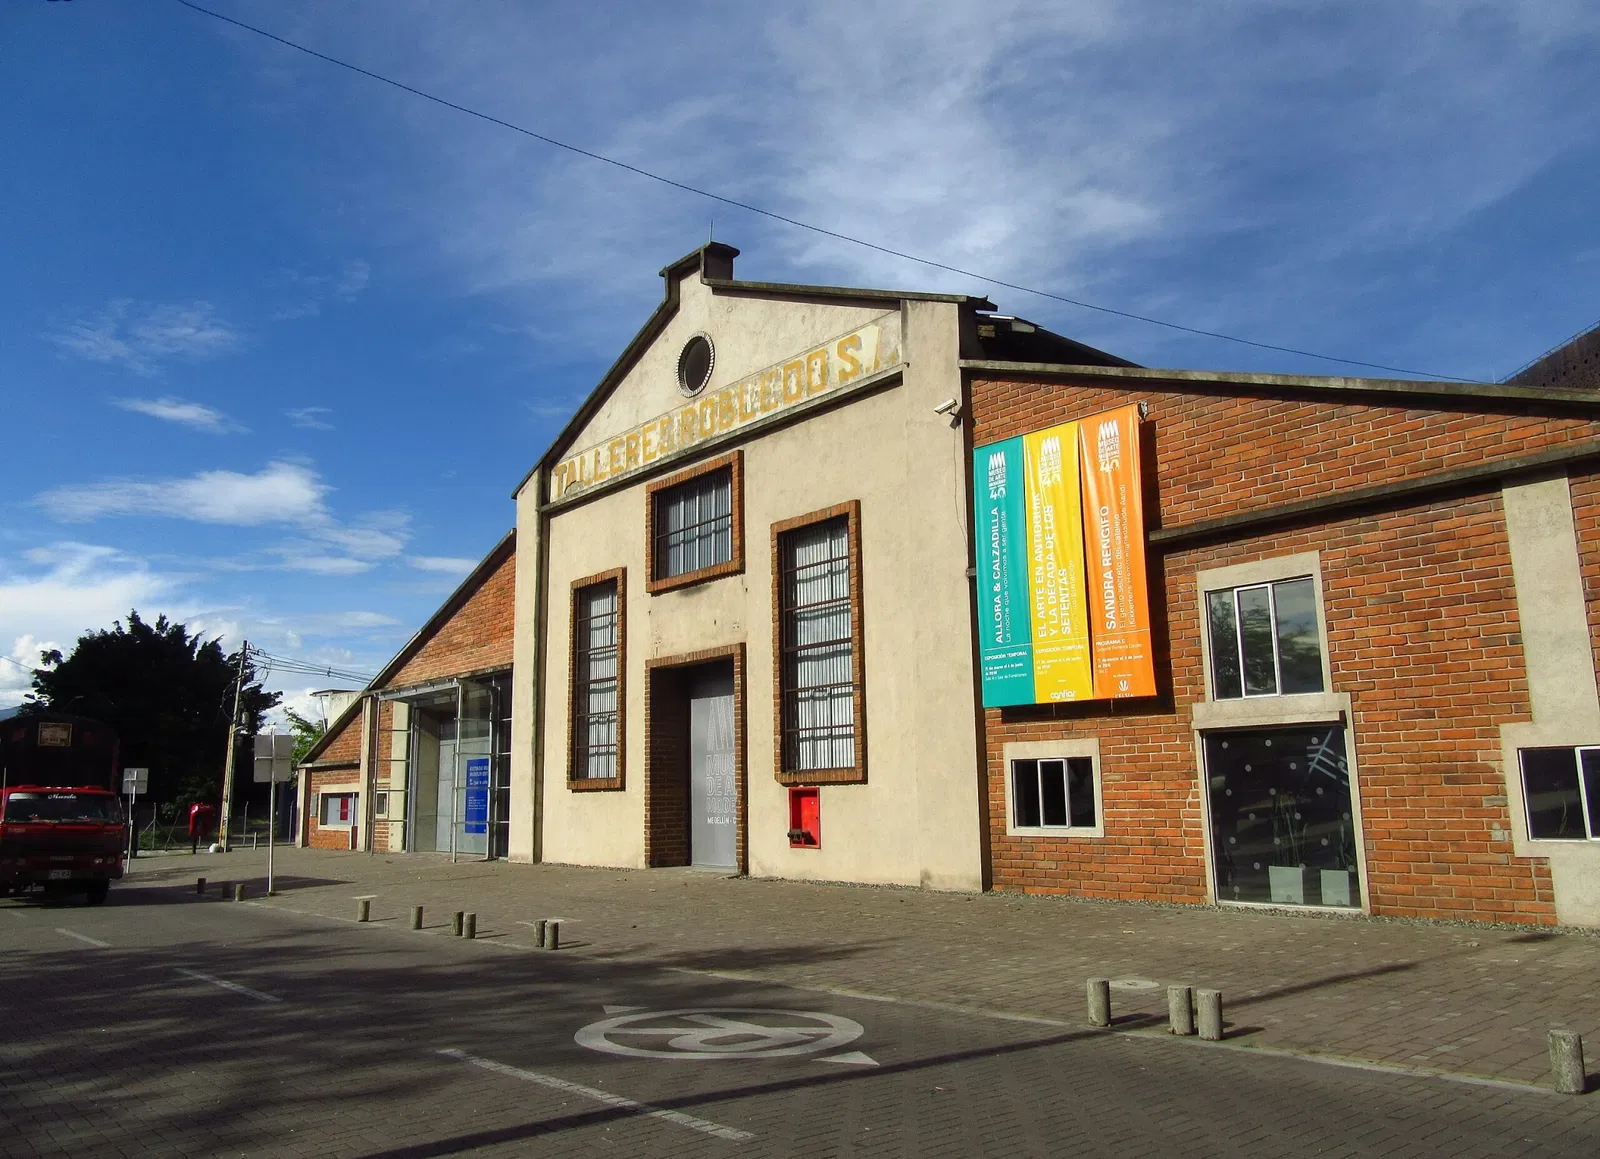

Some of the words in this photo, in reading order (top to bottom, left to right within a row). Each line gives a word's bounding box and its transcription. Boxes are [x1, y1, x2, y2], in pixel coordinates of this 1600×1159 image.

[681, 349, 827, 444] ROBLEDO
[1032, 493, 1043, 563] ANTIOQUIA
[1043, 505, 1053, 530] LOS
[991, 506, 1001, 580] CALZADILLA
[1045, 532, 1054, 549] DE
[1100, 505, 1112, 567] RENGIFO
[1114, 547, 1122, 560] del
[994, 582, 1001, 592] &
[1035, 566, 1044, 584] EN
[1045, 553, 1057, 605] DÉCADA
[1116, 561, 1124, 593] secreto
[1036, 587, 1046, 619] ARTE
[1058, 567, 1071, 635] SETENTAS
[1103, 569, 1116, 630] SANDRA
[994, 594, 1004, 643] ALLORA
[1038, 622, 1047, 638] EL
[1048, 607, 1058, 625] LA
[1120, 620, 1126, 629] El
[1005, 633, 1011, 642] La
[1049, 628, 1058, 636] Y
